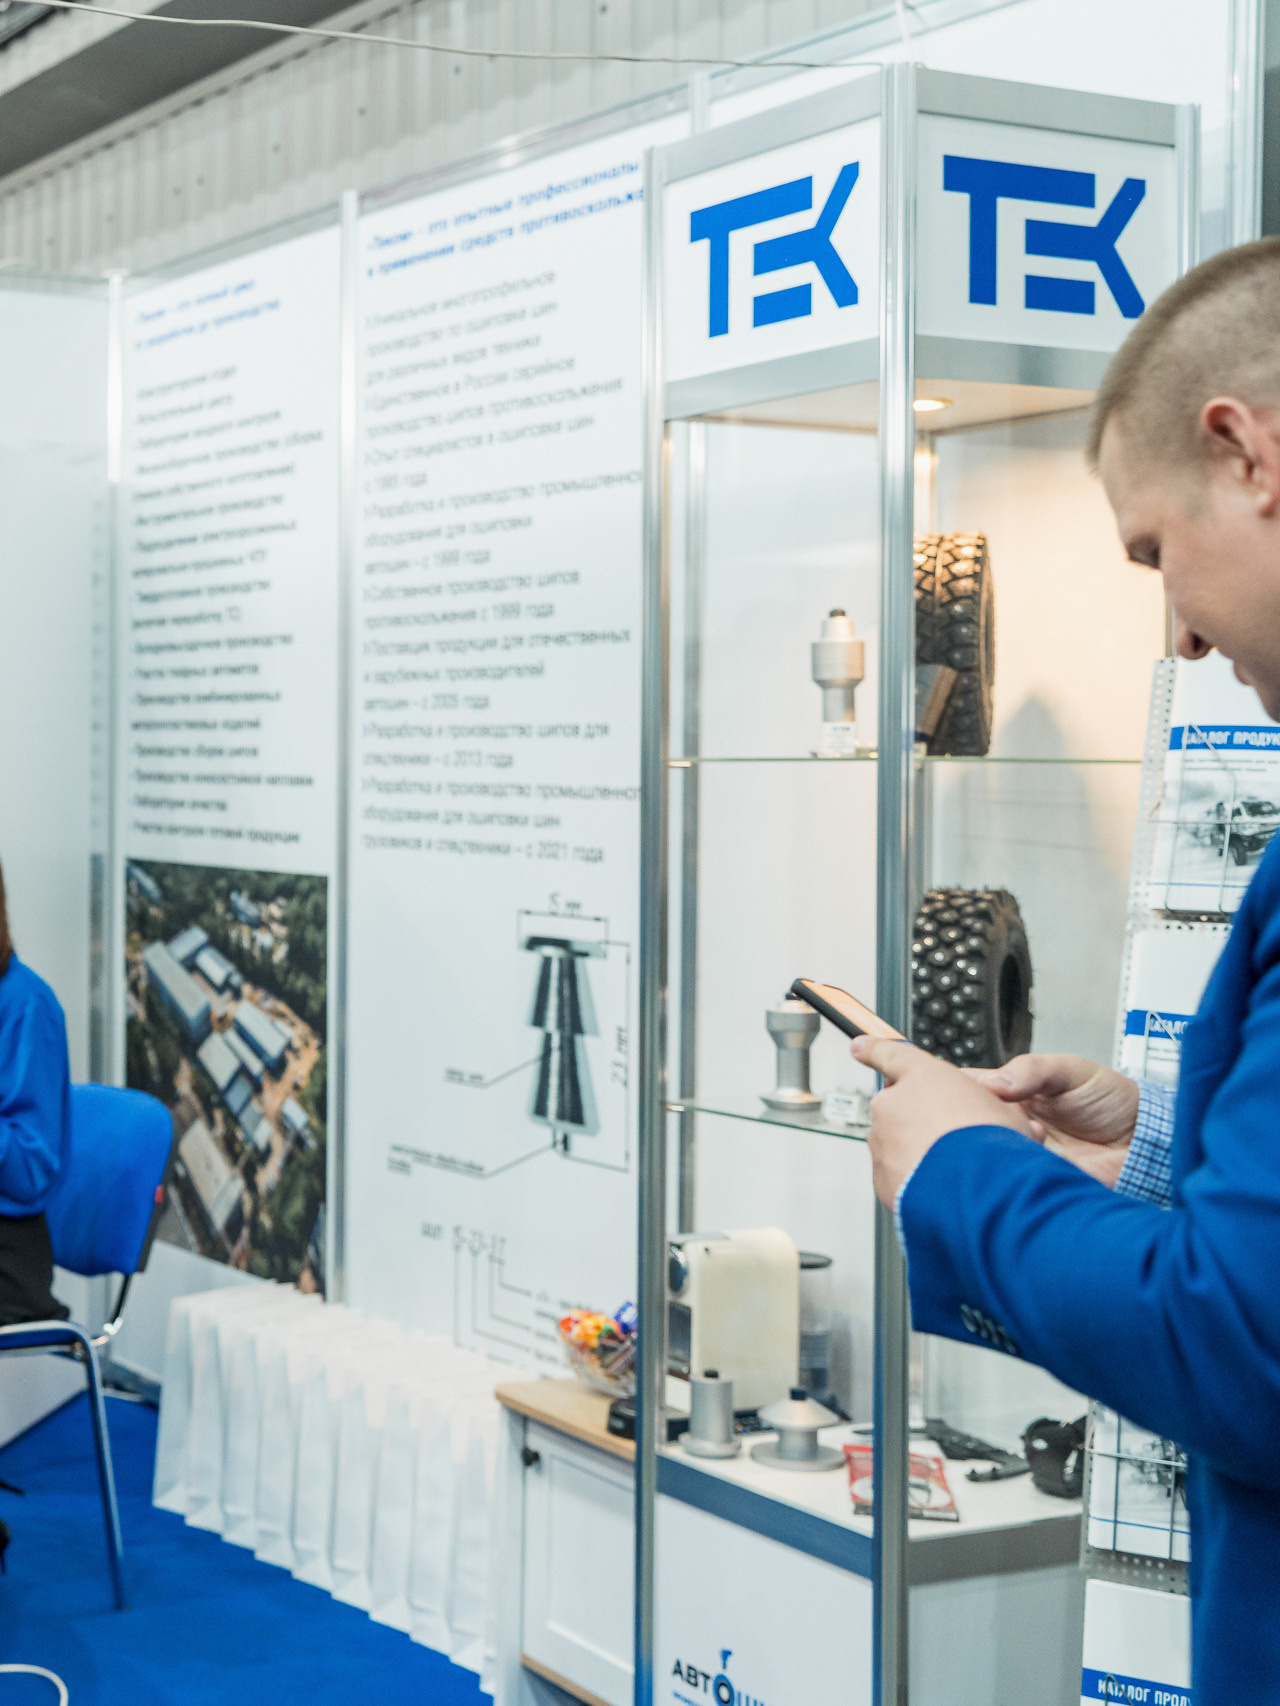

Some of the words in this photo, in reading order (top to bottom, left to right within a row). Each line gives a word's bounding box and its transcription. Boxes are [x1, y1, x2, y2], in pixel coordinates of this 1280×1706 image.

[520, 188, 644, 236] противоскольже
[538, 785, 641, 802] промышленно
[1155, 1690, 1191, 1706] ПРОД
